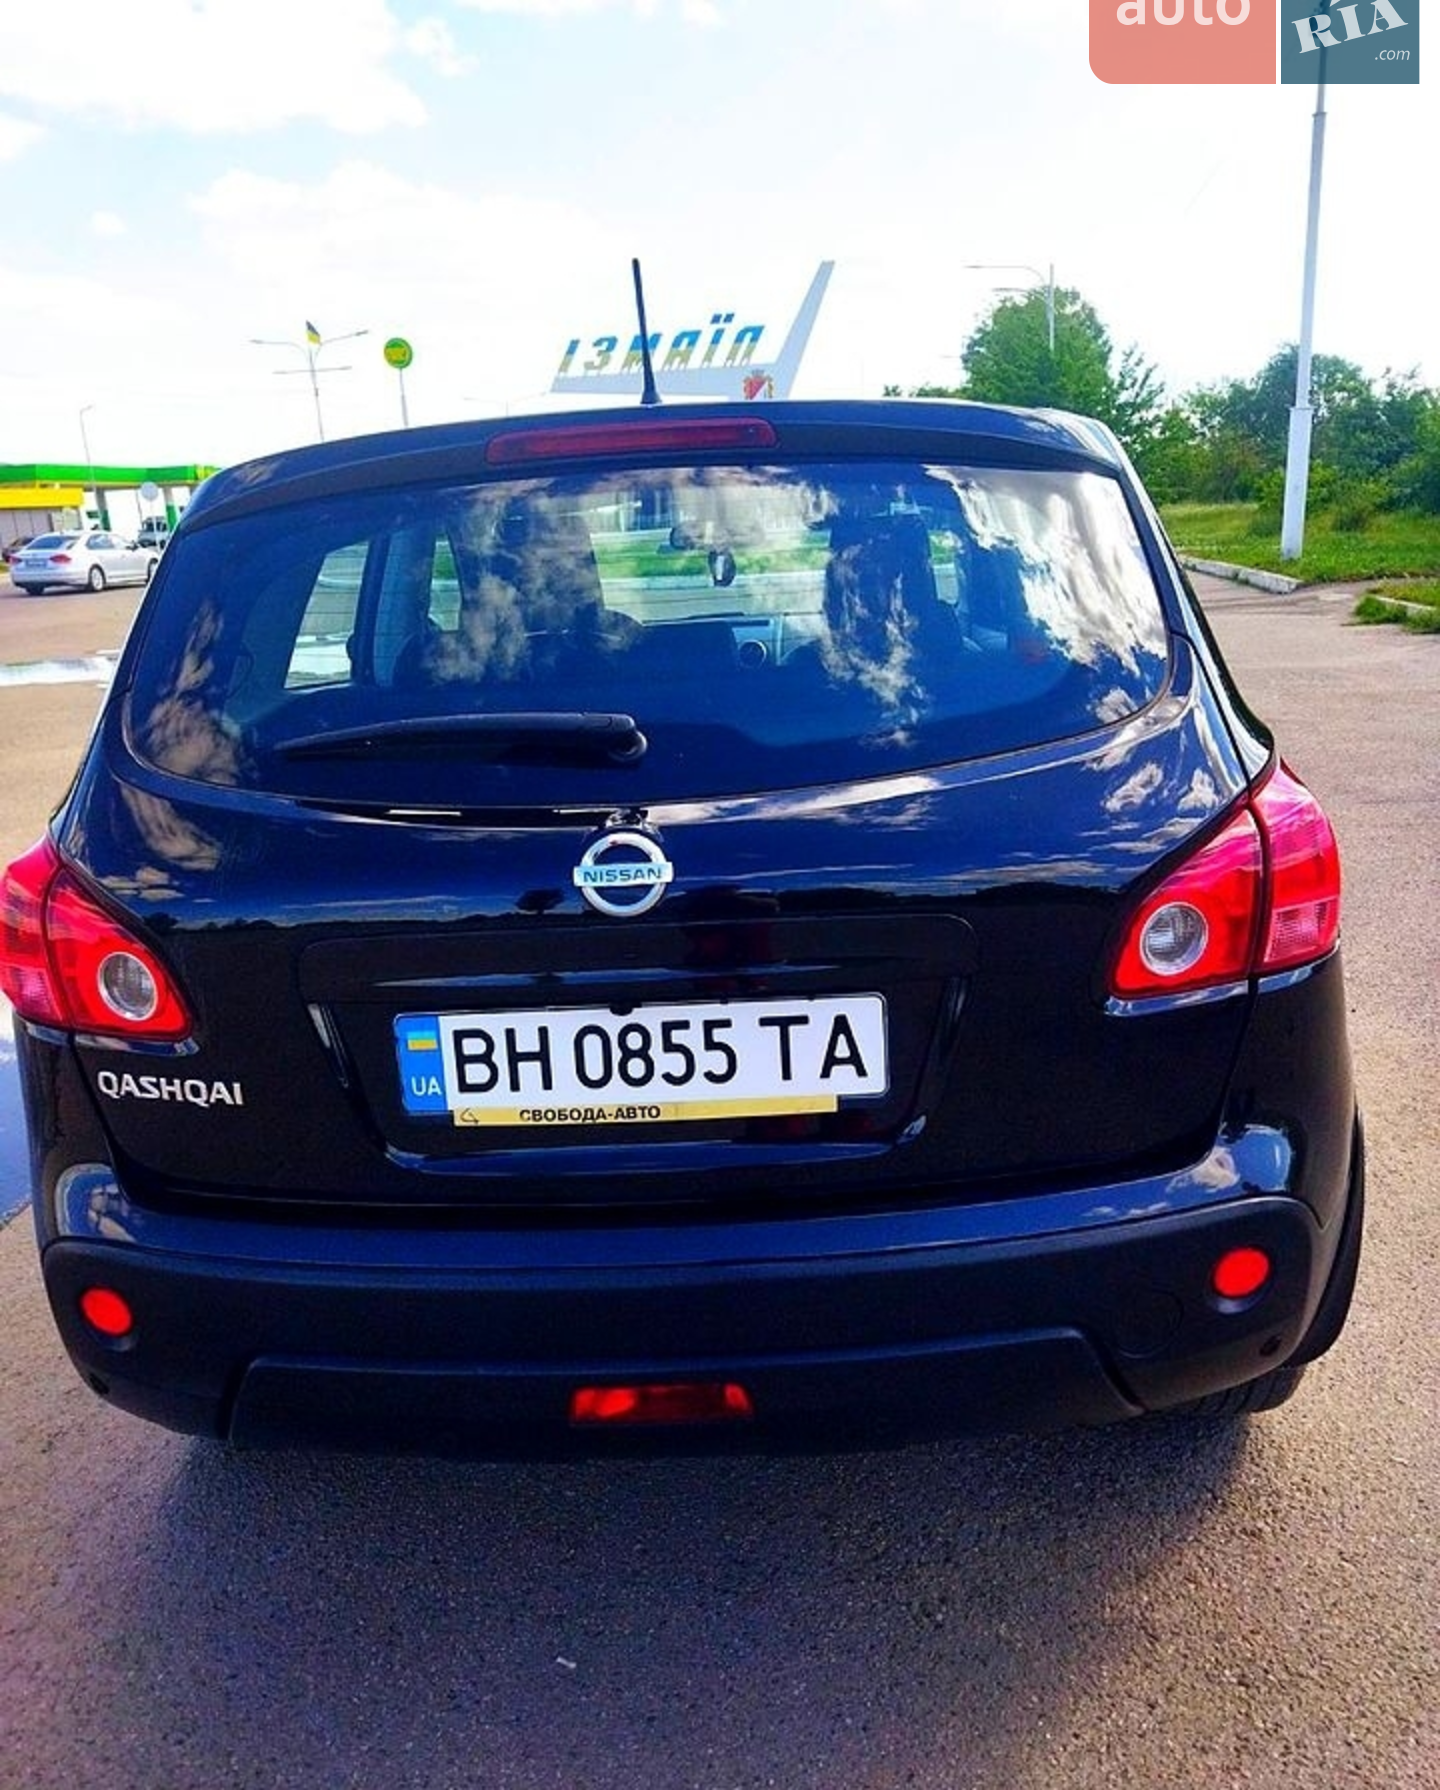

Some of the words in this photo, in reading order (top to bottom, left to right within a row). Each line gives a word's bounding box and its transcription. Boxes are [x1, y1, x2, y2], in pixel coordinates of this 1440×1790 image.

[583, 867, 662, 883] NISSAN
[452, 1025, 554, 1094] BH
[573, 1018, 738, 1089] 0855
[758, 1014, 868, 1080] TA
[97, 1070, 244, 1108] QASHQAI
[411, 1075, 442, 1096] UA
[519, 1105, 661, 1123] СВОБОДА-АВТО
